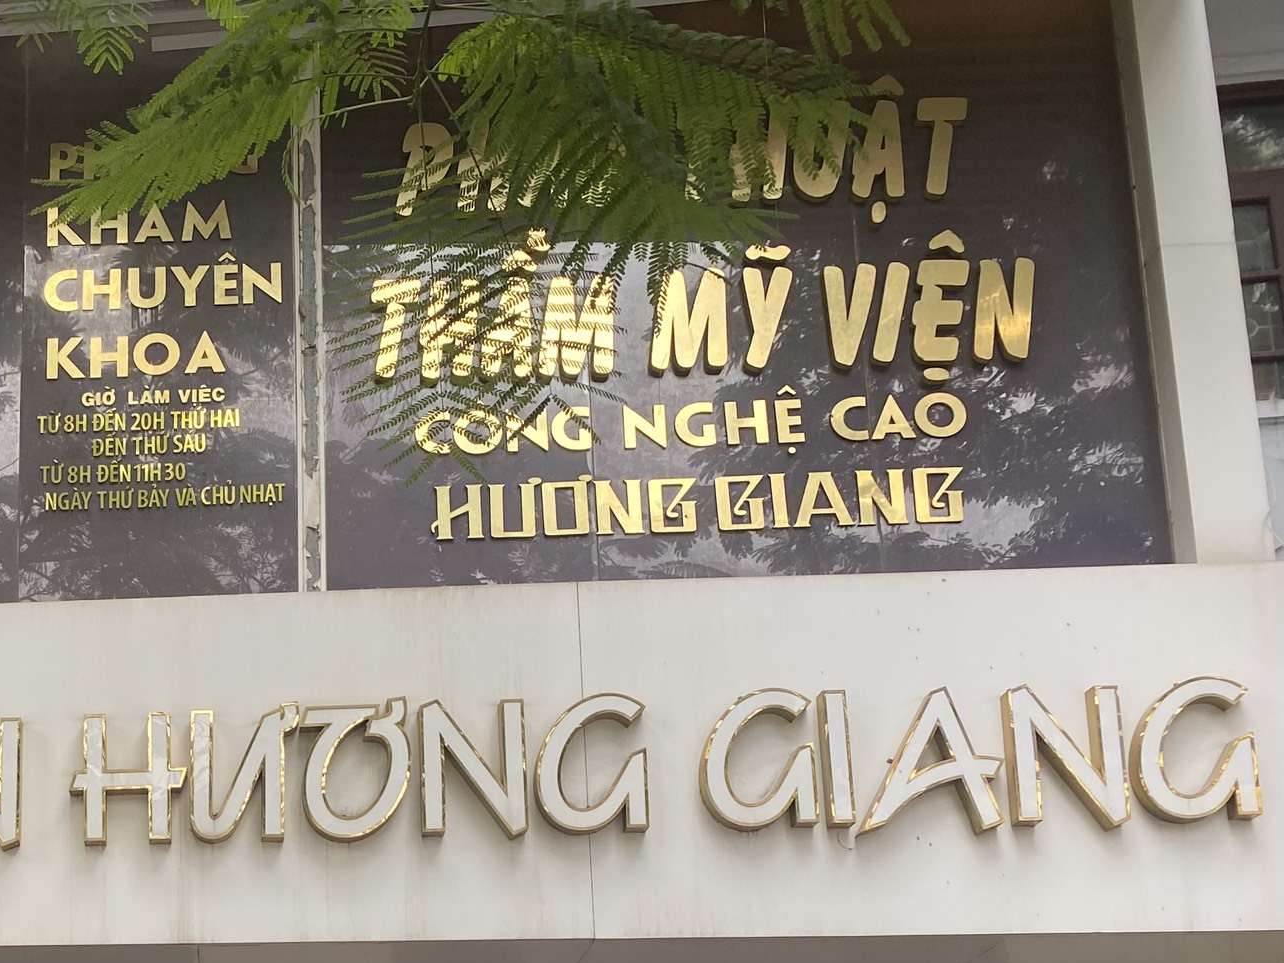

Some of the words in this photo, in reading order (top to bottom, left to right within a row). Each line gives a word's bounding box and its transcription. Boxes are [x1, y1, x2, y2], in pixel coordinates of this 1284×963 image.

[43, 251, 282, 312] CHUYÊN
[371, 227, 616, 384] THẨM
[650, 245, 793, 376] MỸ
[823, 229, 1036, 383] VIỆN
[46, 330, 226, 380] KHOA
[37, 410, 62, 434] TỪ
[63, 413, 87, 432] 8H
[91, 407, 126, 432] ĐẾN
[130, 411, 165, 432] 20H
[170, 405, 207, 430] THỨ
[210, 408, 241, 429] HAI
[81, 385, 116, 407] GIỜ
[127, 384, 171, 405] LÀM
[624, 385, 806, 455] NGHỆ
[830, 392, 968, 442] CAO
[91, 432, 127, 457] ĐẾN
[39, 459, 65, 484] TỪ
[67, 463, 92, 484] 8H
[96, 458, 131, 483] ĐẾN
[45, 487, 92, 511] NGÀY
[96, 485, 135, 510] THỨ
[137, 483, 170, 508] BẢY
[175, 482, 197, 507] VÀ
[200, 479, 236, 506] CHỦ
[430, 474, 698, 541] HƯƠNG
[715, 467, 965, 532] GIANG
[69, 692, 651, 847] HƯƠNG
[698, 675, 1264, 838] GIANG
